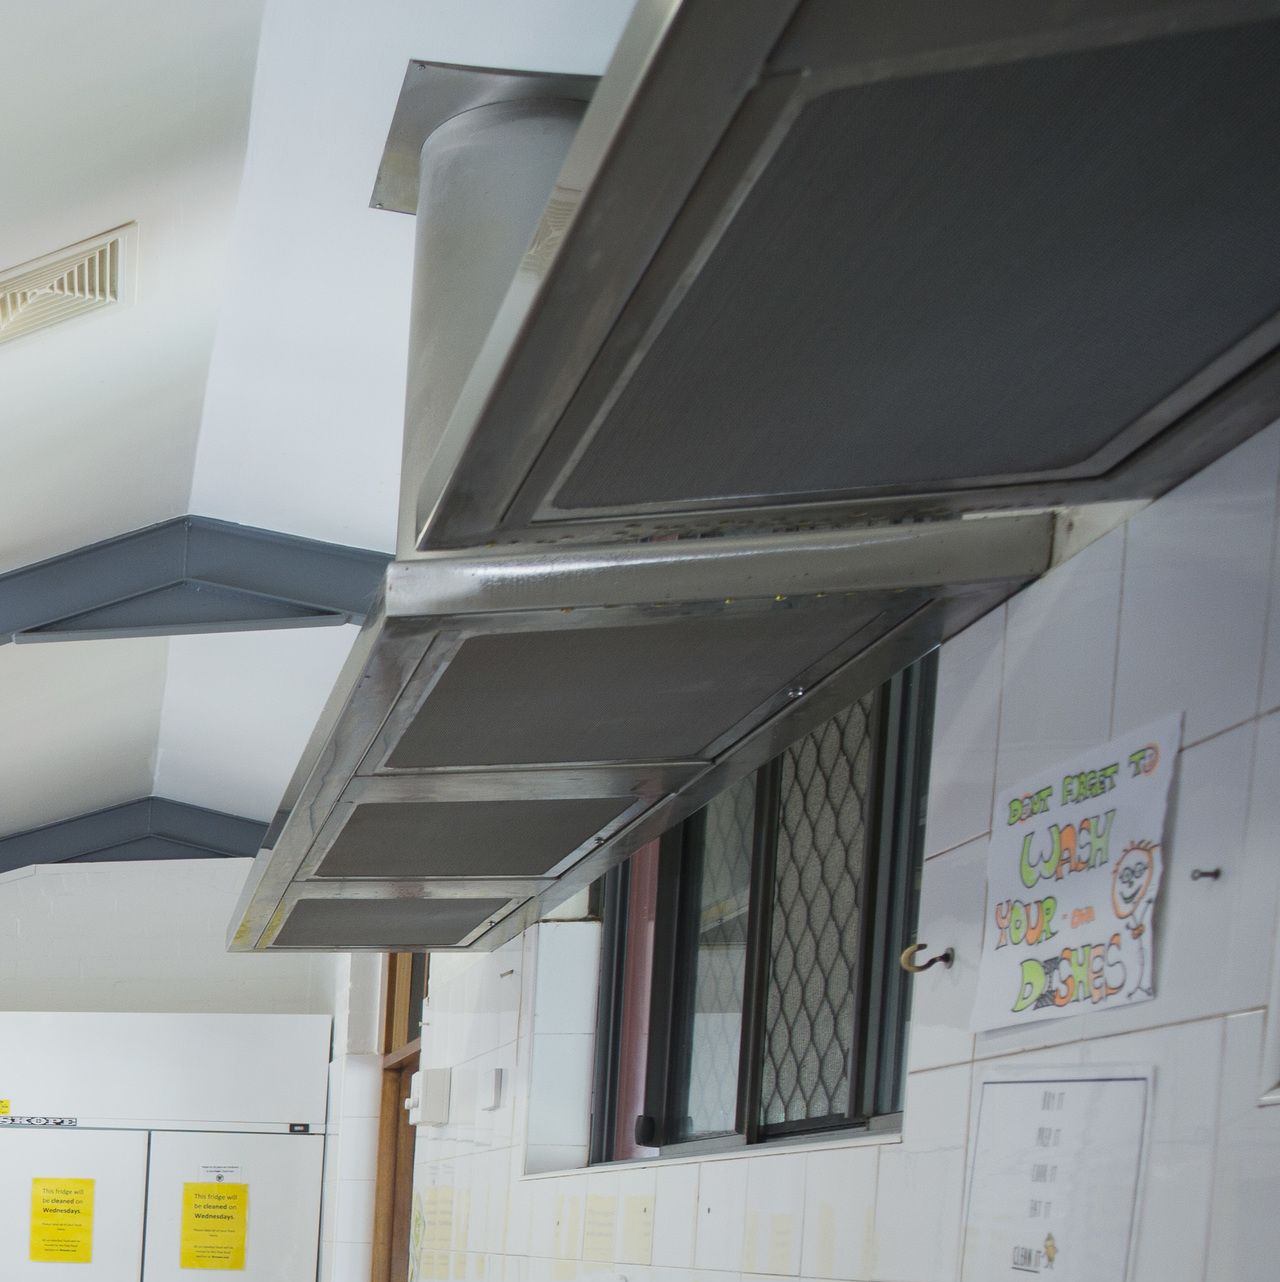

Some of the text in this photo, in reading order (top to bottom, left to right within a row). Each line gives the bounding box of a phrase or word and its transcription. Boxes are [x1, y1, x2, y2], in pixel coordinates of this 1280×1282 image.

[1128, 741, 1161, 778] TO
[1019, 808, 1117, 889] WASH
[993, 895, 1059, 951] YOUR
[1011, 932, 1127, 1013] DISHES
[207, 1193, 225, 1201] fridge
